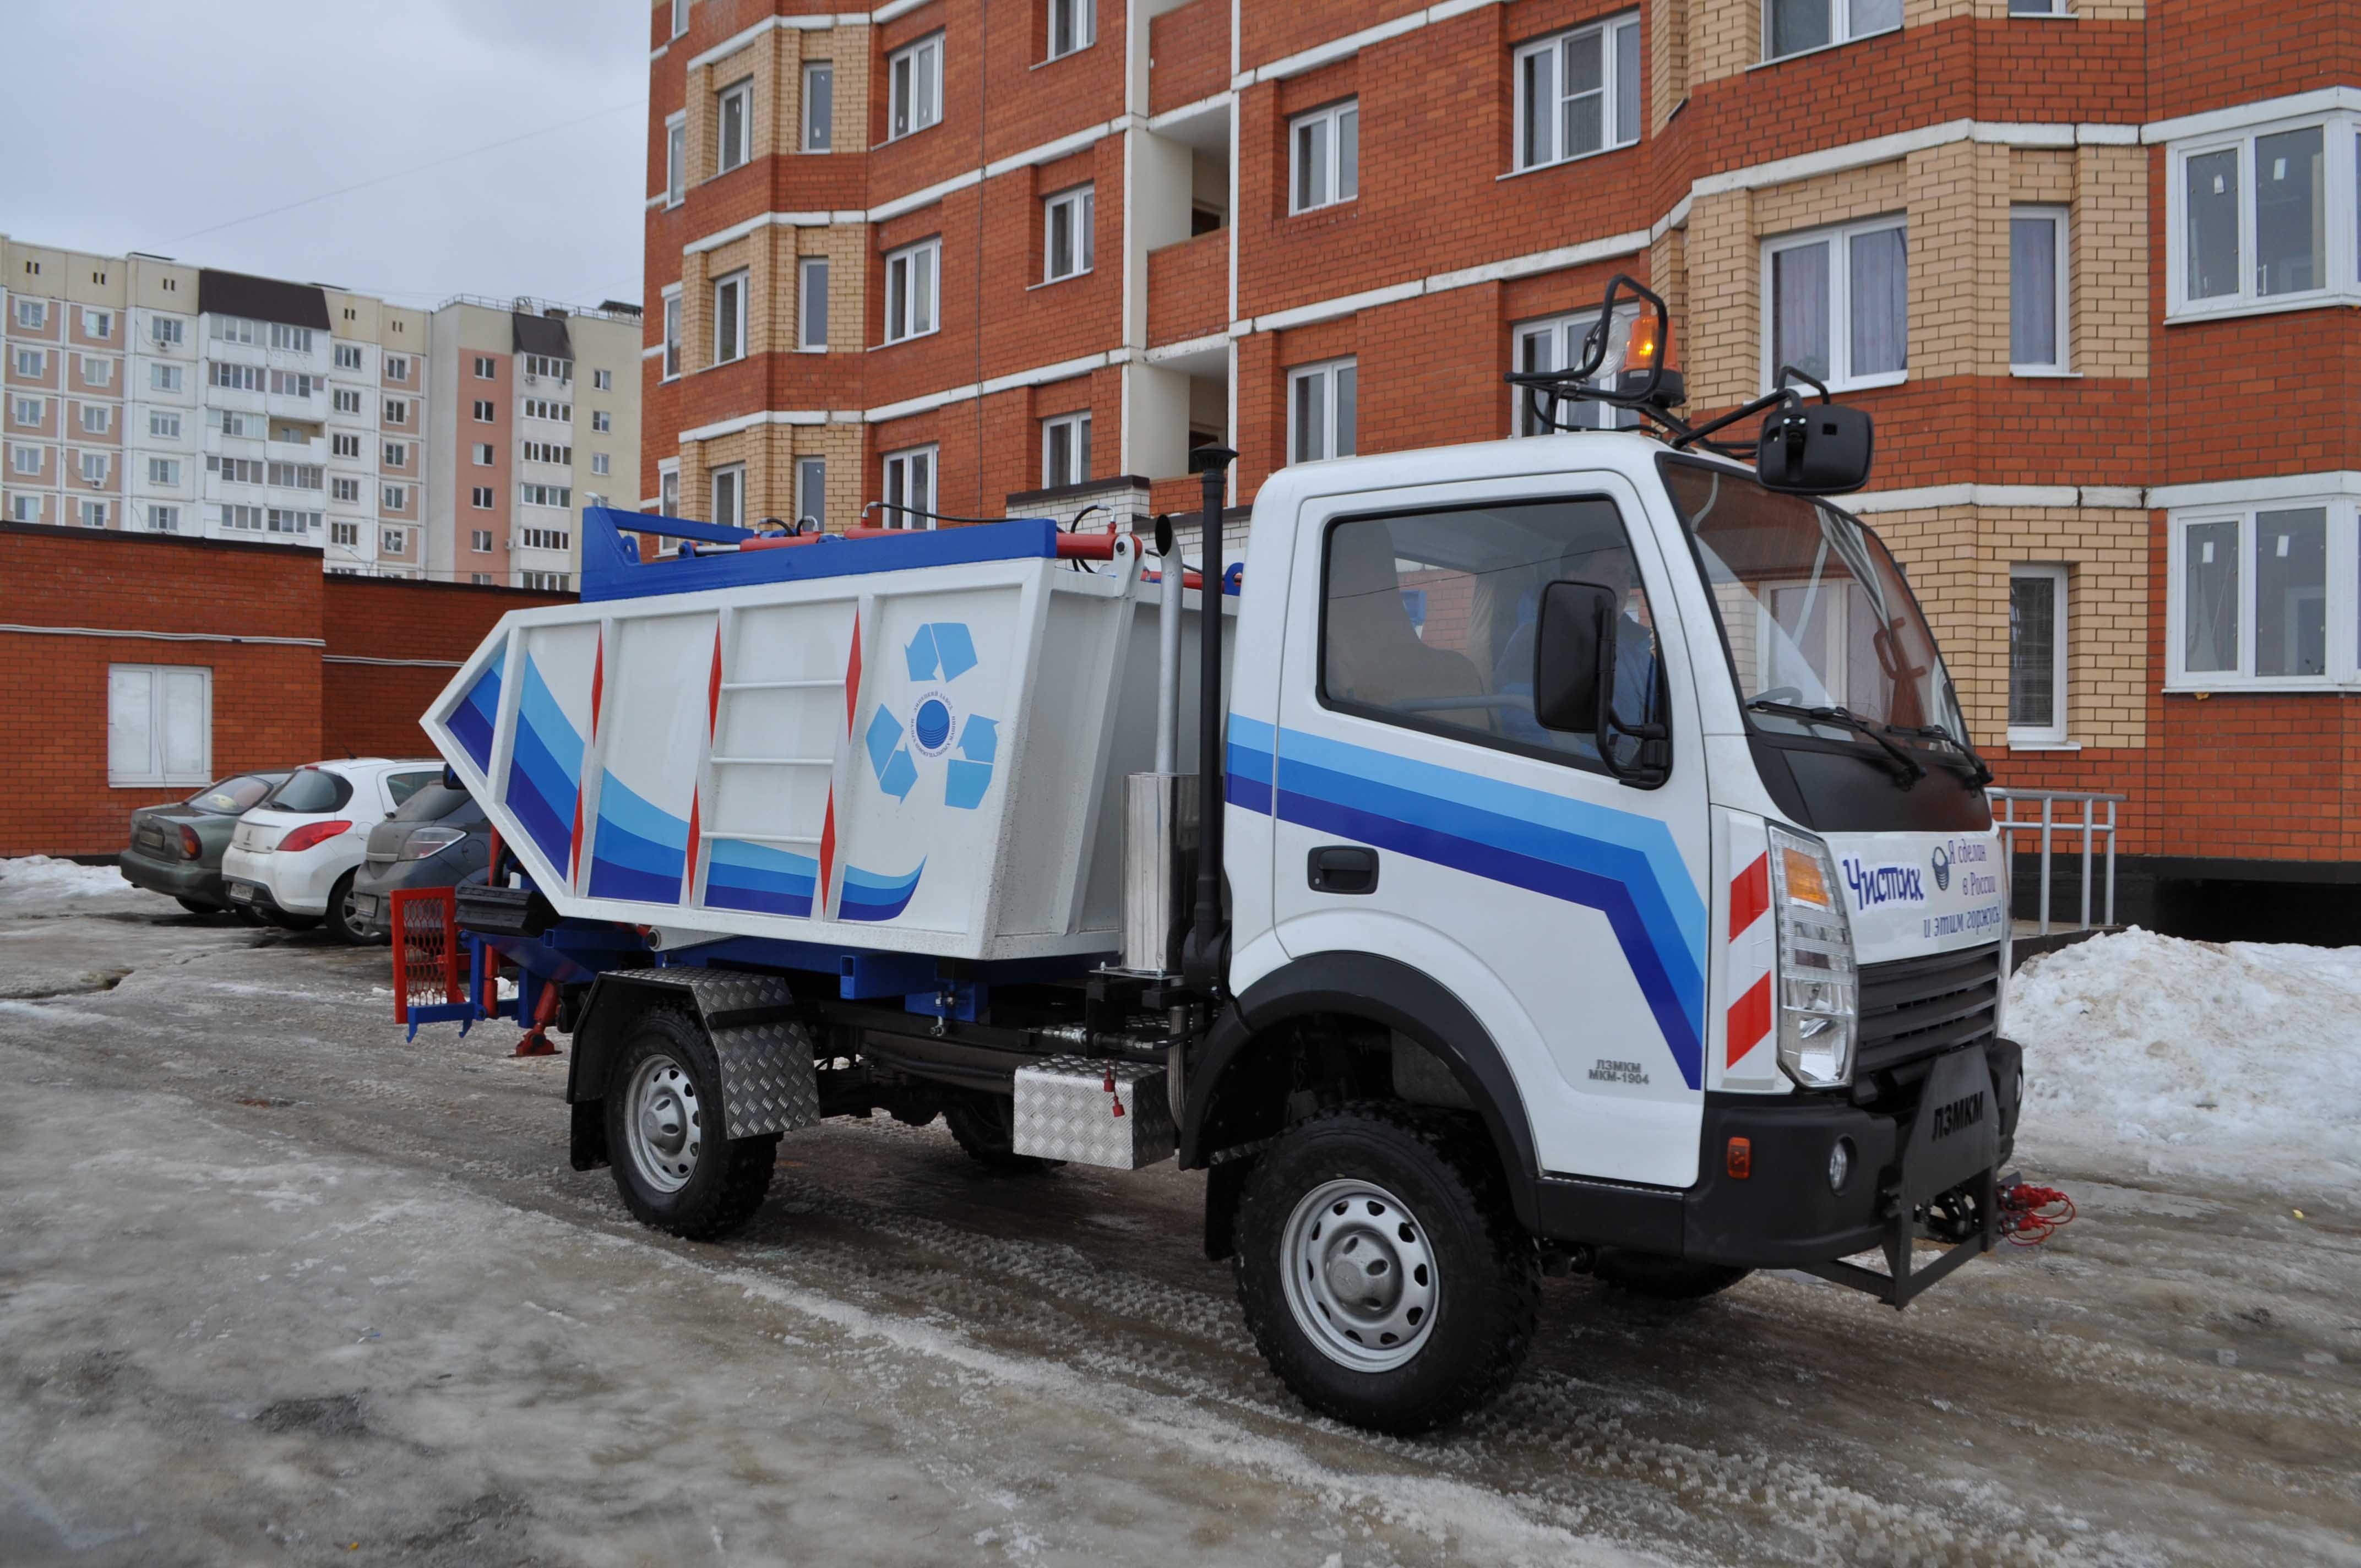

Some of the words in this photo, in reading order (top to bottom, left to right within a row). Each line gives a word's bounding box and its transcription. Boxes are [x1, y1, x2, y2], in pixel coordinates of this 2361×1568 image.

[1947, 840, 1956, 864] Я
[1958, 838, 1987, 863] сделан
[1842, 858, 1924, 910] Чистик
[1962, 878, 1968, 896] в
[1970, 872, 1996, 896] России
[1923, 919, 1931, 938] и
[1934, 913, 1964, 937] этим
[1589, 1069, 1649, 1085] МКМ-1904
[1596, 1059, 1641, 1073] ЛЗМКМ
[1932, 1090, 1984, 1144] ЛЗМКМ
